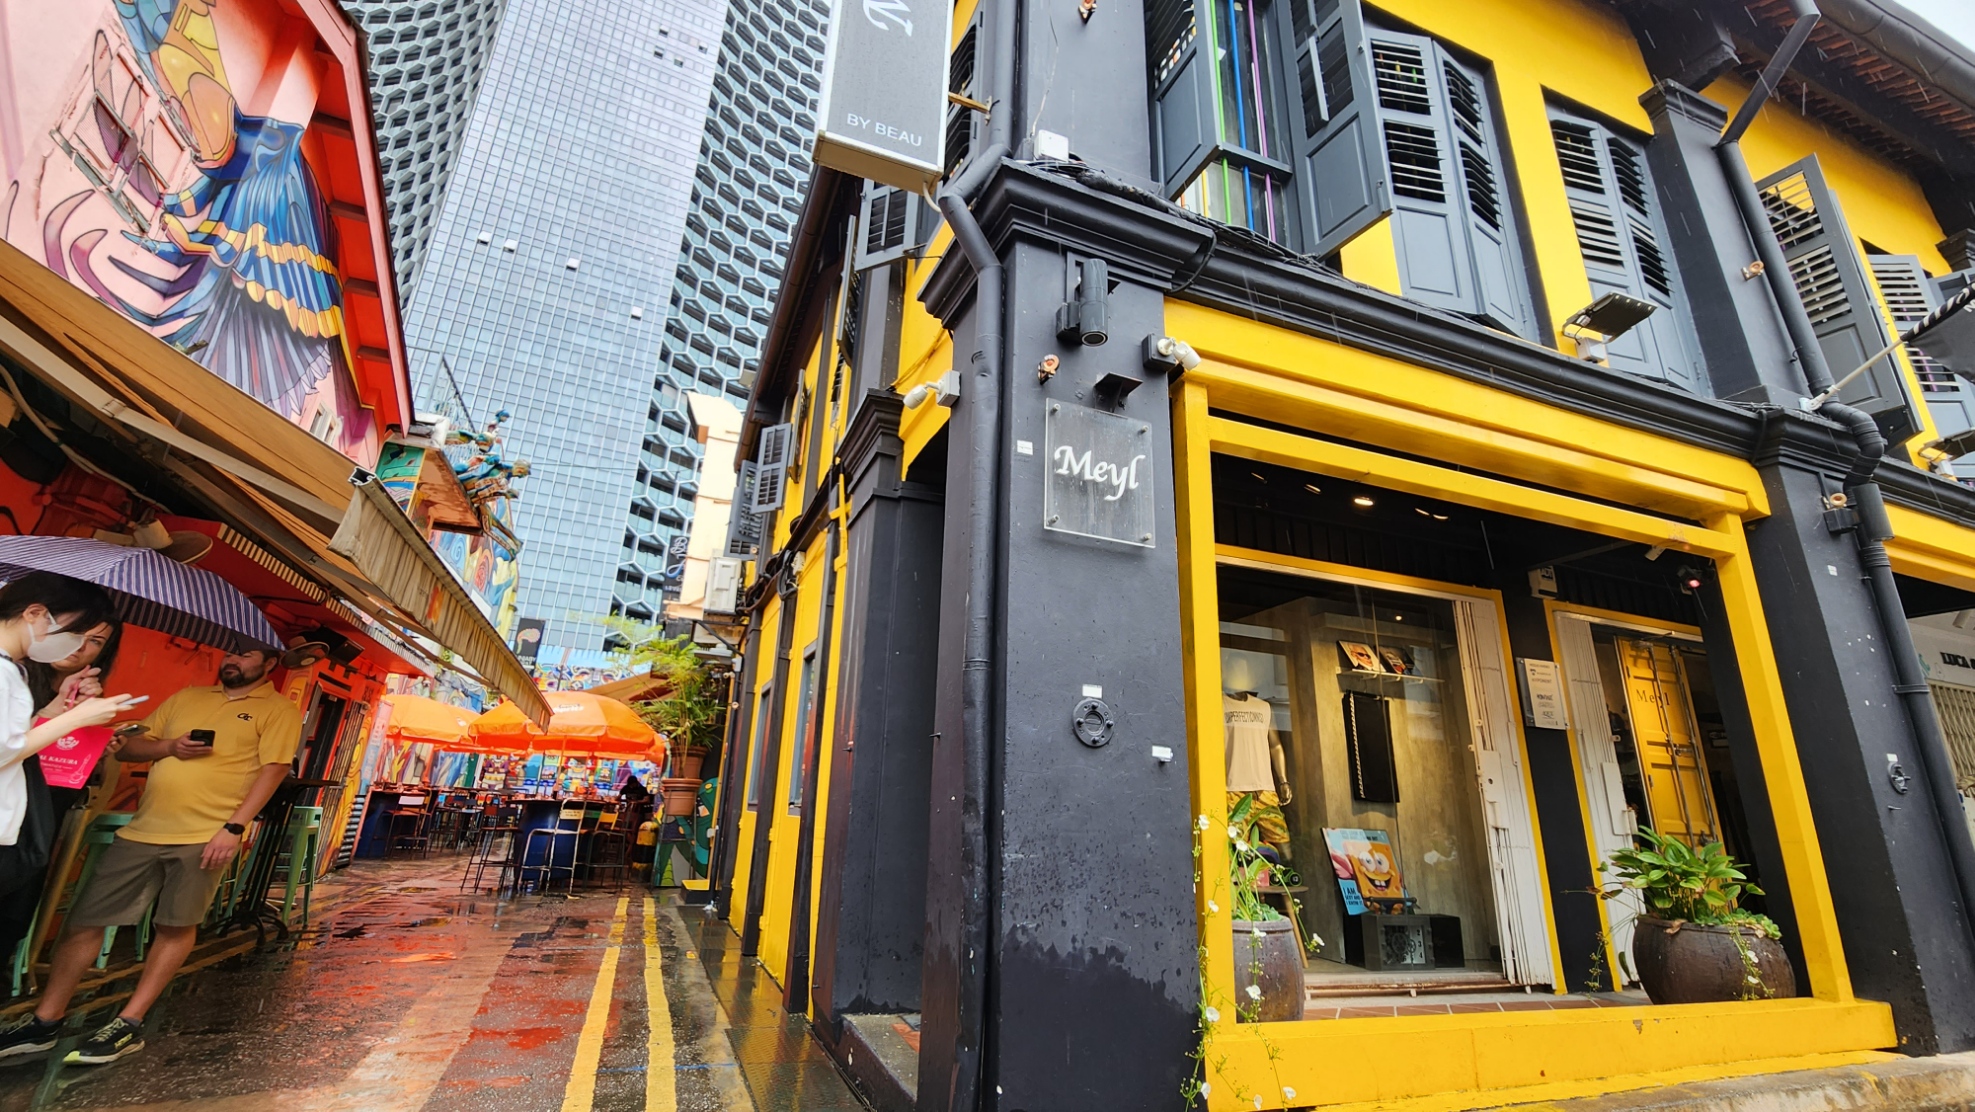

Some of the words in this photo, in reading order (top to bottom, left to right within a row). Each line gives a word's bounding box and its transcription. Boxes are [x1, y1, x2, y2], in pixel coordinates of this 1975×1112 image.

[847, 113, 871, 130] BY
[875, 122, 922, 147] BEAU
[1054, 445, 1146, 501] Meyl
[1940, 651, 1971, 669] LUCA
